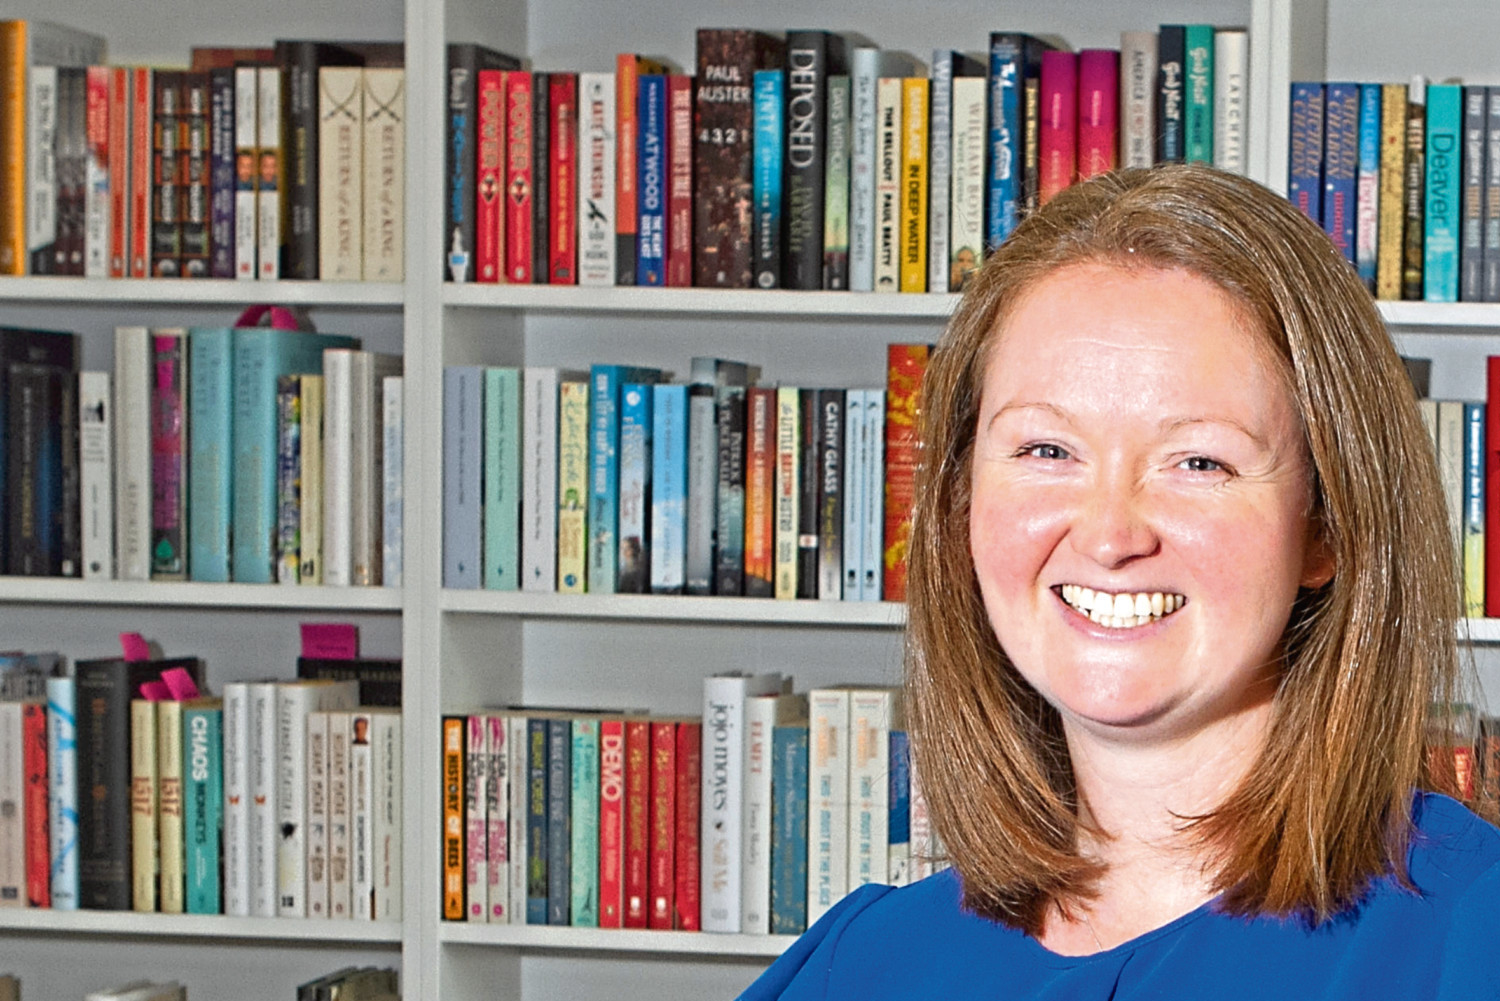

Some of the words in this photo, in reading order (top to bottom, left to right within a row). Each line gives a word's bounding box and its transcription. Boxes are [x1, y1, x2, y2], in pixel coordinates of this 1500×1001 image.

[698, 86, 750, 103] AUSTER
[706, 66, 741, 81] PAUL
[482, 90, 498, 168] POWER
[511, 91, 529, 171] POWER
[592, 101, 604, 130] KATE
[760, 80, 775, 133] MINTY
[789, 49, 816, 168] DEPOSED
[338, 125, 350, 184] RETURN
[382, 125, 394, 184] RETURN
[968, 102, 981, 177] WILLIAM
[1293, 101, 1305, 176] CHABON
[1308, 95, 1320, 178] MICHAEL
[1327, 102, 1340, 177] CHABON
[1342, 95, 1355, 180] MICHAEL
[592, 136, 604, 200] ATKINSON
[645, 133, 658, 209] ATWOOD
[1431, 133, 1455, 224] Deaver
[883, 194, 893, 223] PAUL
[908, 181, 919, 216] DEEP
[967, 185, 980, 233] BOYD
[908, 218, 919, 263] WATER
[825, 402, 837, 446] CATHY
[825, 449, 837, 493] GLASS
[191, 716, 208, 780] CHAOS
[709, 704, 734, 742] jojo
[133, 777, 153, 817] 1517
[162, 777, 180, 817] 1517
[447, 754, 459, 812] HISTORY
[602, 734, 622, 802] DEMO
[709, 747, 730, 811] moyes
[447, 838, 459, 868] BEES
[713, 838, 728, 866] Still
